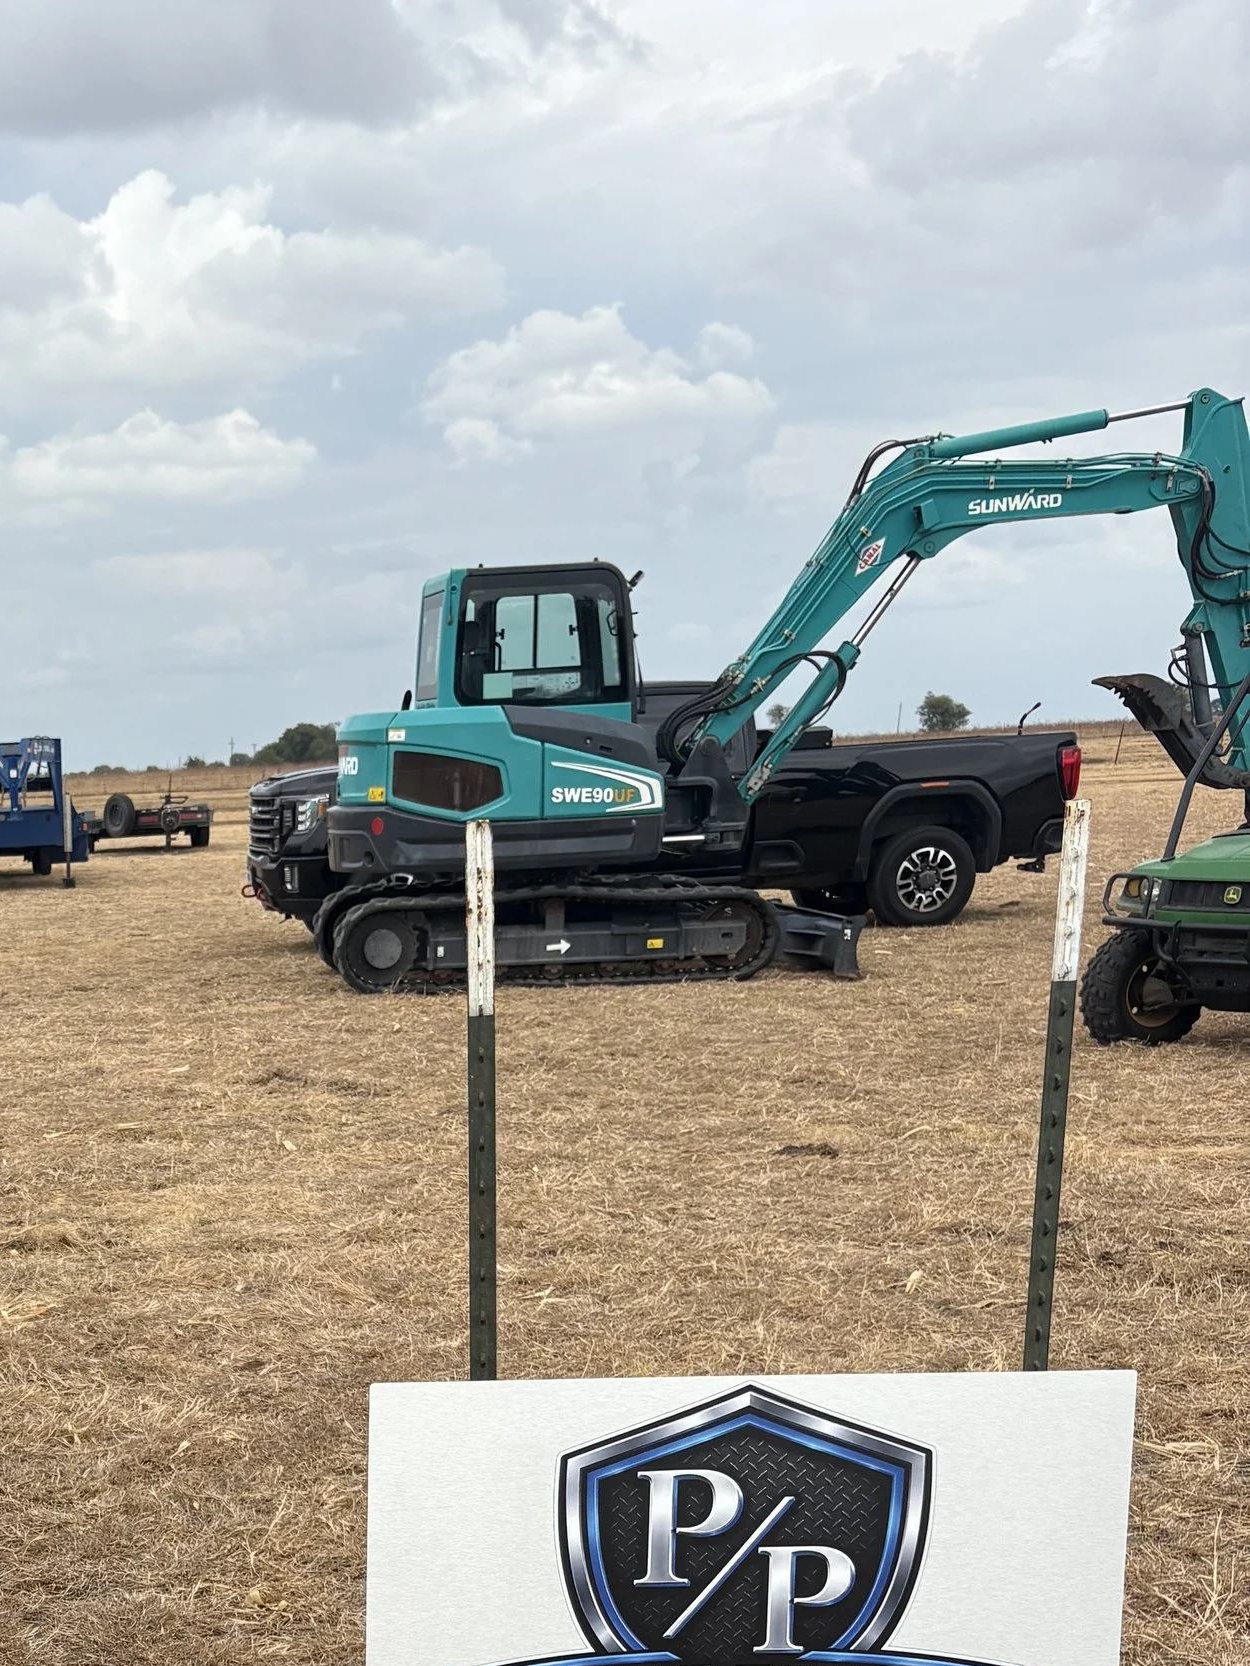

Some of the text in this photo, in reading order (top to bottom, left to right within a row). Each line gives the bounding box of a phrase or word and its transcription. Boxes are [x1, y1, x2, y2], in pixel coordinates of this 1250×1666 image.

[968, 488, 1062, 515] SUNWARD
[858, 543, 881, 570] CANAL
[551, 787, 635, 804] SWE90UF
